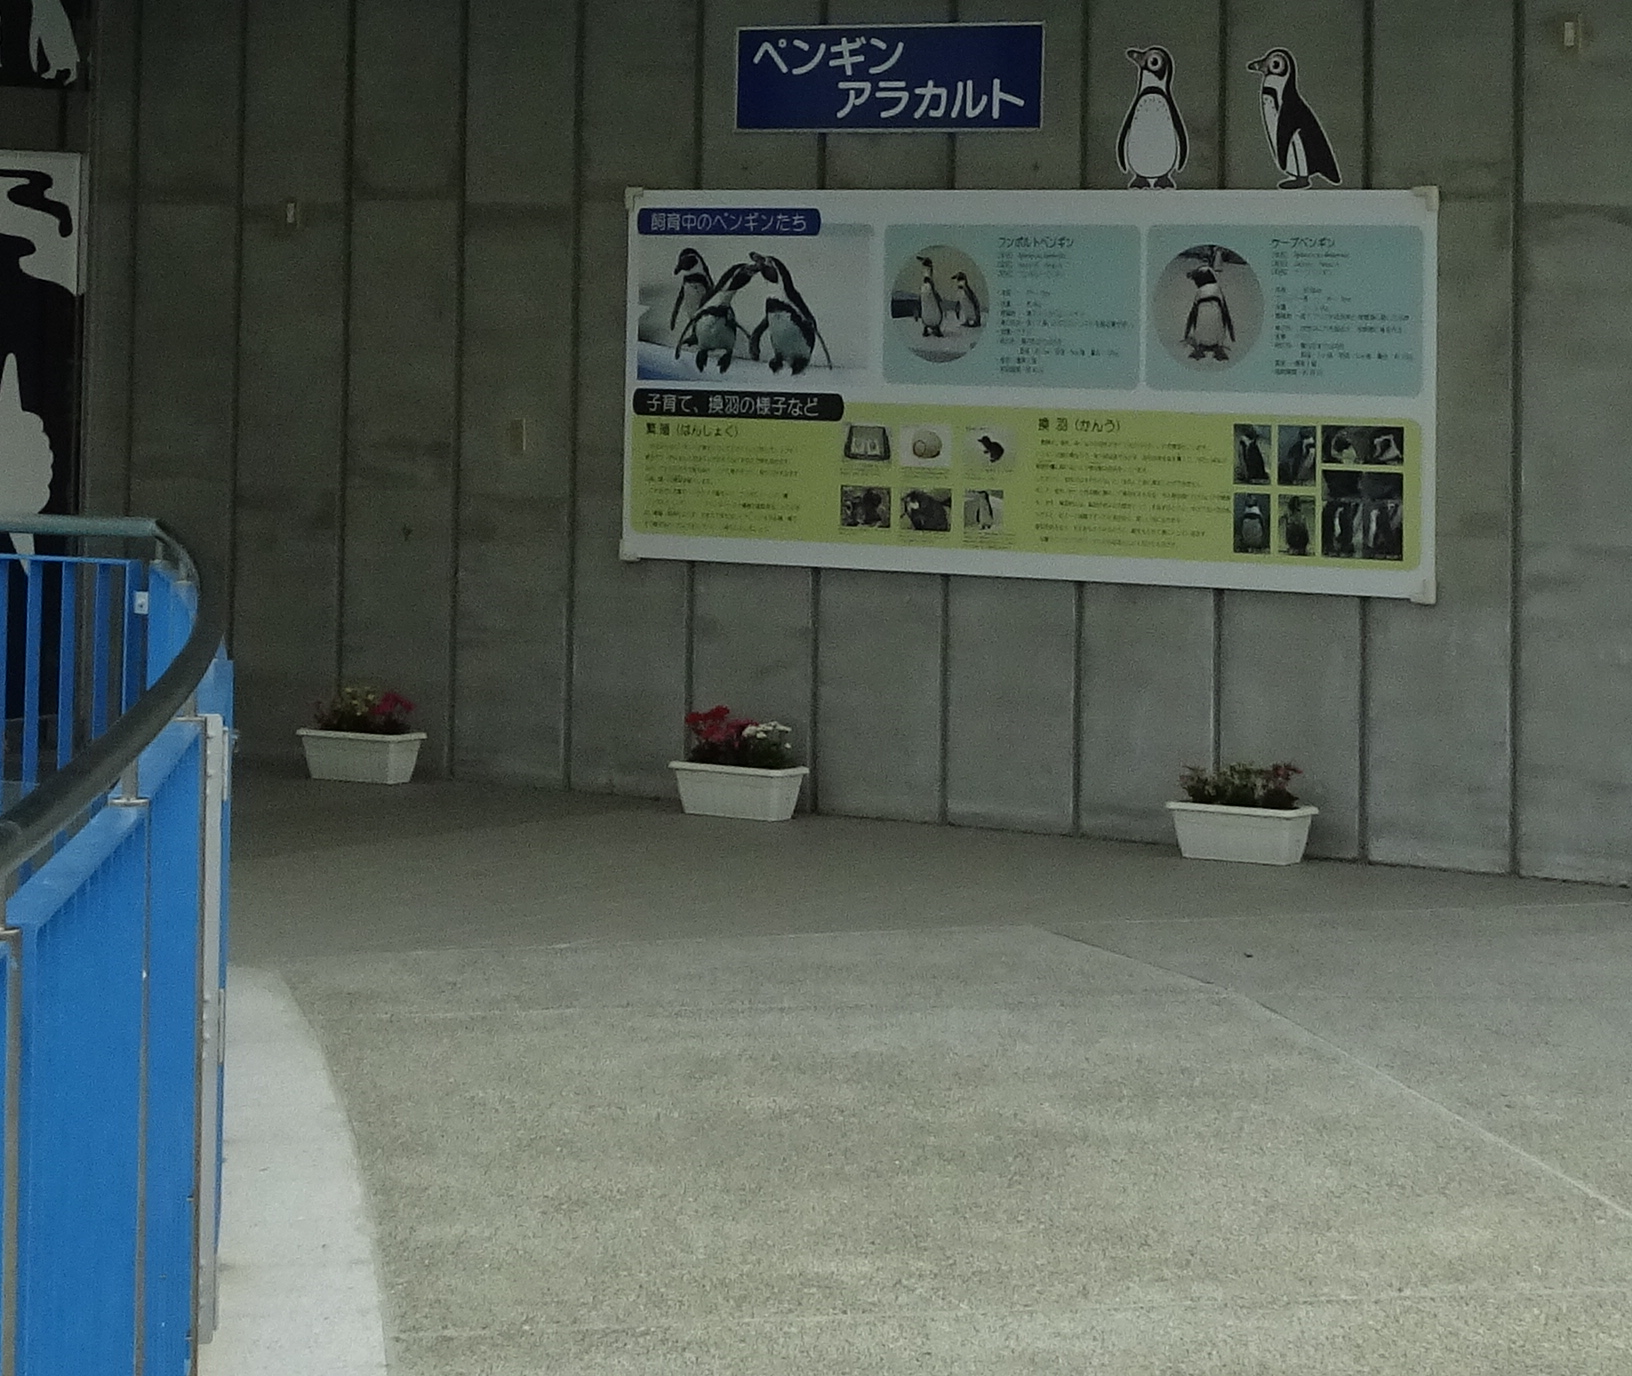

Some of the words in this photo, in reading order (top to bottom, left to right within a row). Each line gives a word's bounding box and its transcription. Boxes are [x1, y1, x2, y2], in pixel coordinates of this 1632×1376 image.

[752, 37, 904, 75] ペンギン
[836, 78, 1025, 119] アラカルト
[650, 212, 807, 232] 飼育中のペンギンたち
